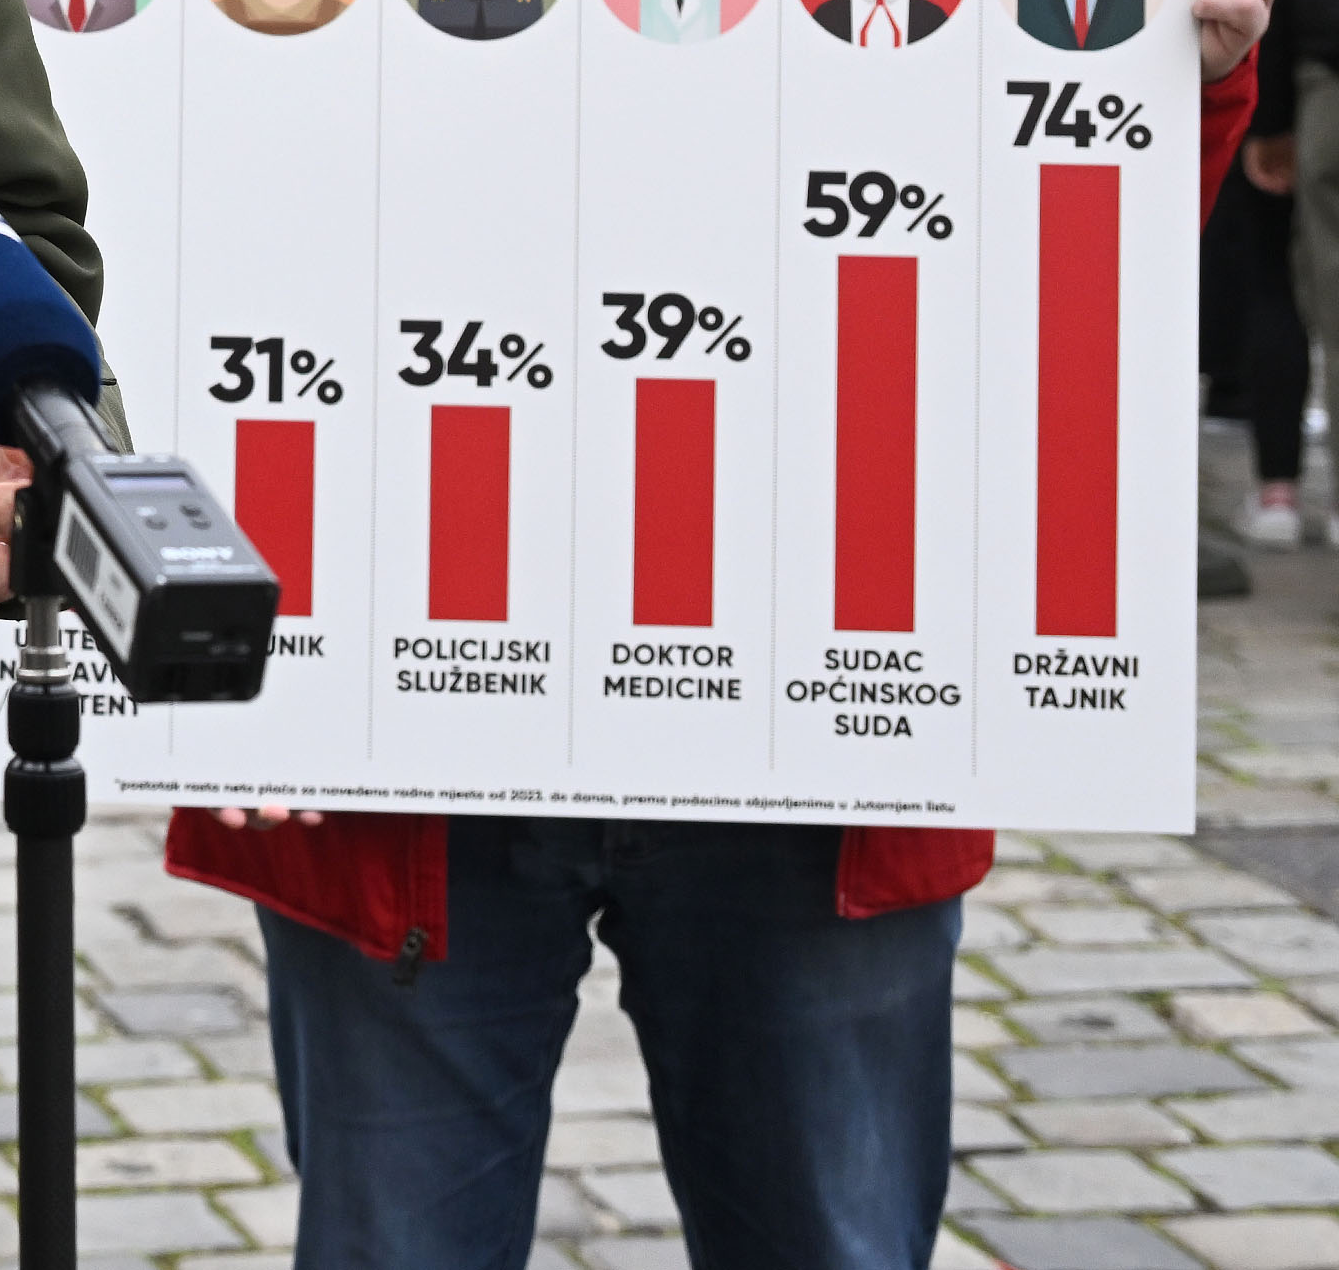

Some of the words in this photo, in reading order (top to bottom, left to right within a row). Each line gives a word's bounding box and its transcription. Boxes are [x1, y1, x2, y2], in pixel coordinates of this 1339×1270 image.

[1006, 80, 1152, 150] 74%
[802, 170, 954, 241] 59%
[600, 292, 752, 363] 39%
[398, 319, 554, 390] 34%
[208, 335, 344, 406] 31%
[394, 637, 550, 663] POLICIJSKI
[612, 643, 733, 667] DOKTOR
[824, 648, 923, 673] SUDAC
[1014, 649, 1139, 678] DRŽAVNI
[397, 666, 547, 695] SLUŽBENIK
[604, 675, 742, 701] MEDICINE
[786, 675, 962, 706] OPĆINSKOG
[1025, 686, 1126, 710] TAJNIK
[834, 714, 913, 738] SUDA
